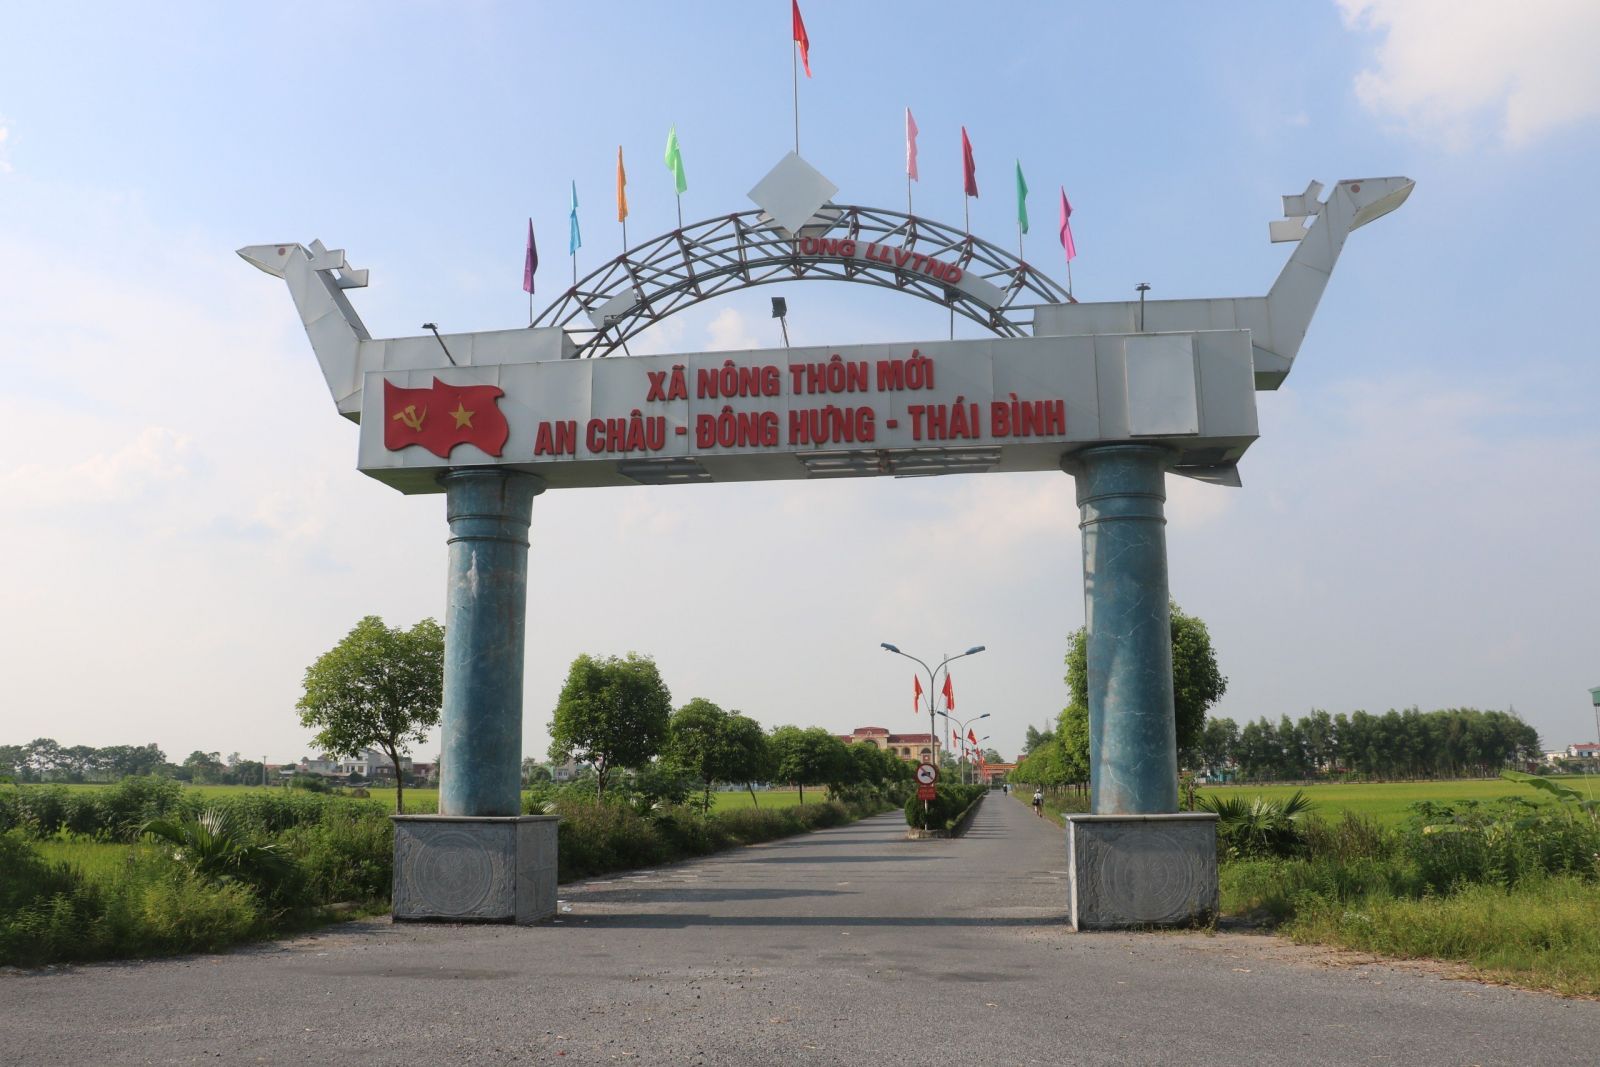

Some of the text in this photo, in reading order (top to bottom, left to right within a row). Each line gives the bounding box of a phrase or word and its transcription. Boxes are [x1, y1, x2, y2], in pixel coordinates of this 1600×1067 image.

[647, 349, 935, 402] XÃ NÔNG THÔN MỚI
[534, 420, 577, 456] AN
[586, 409, 667, 452] CHÂU
[695, 406, 779, 448] ĐÔNG
[788, 404, 876, 445] HƯNG
[908, 395, 981, 441] THÁI
[990, 392, 1066, 437] BÌNH
